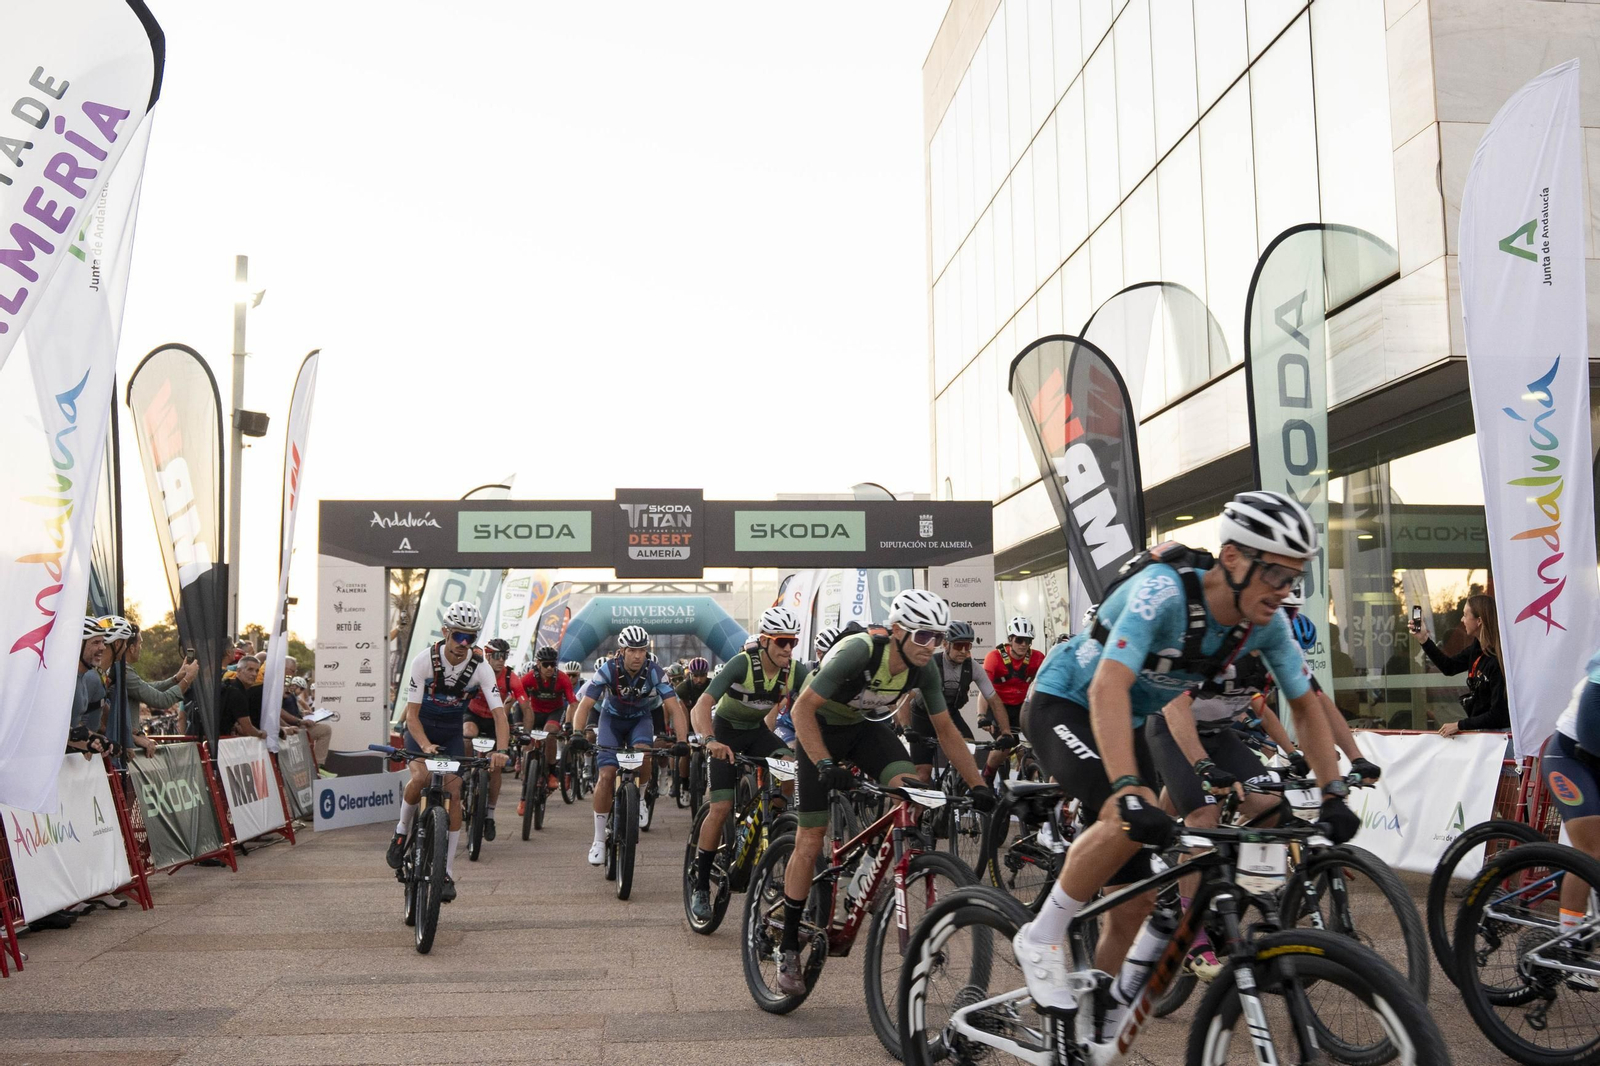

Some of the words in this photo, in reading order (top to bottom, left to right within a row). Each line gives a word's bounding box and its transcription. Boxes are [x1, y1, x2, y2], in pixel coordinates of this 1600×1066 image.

[11, 65, 70, 130] DE
[0, 101, 130, 334] LMERÍA
[1539, 187, 1550, 238] Andalucía
[94, 239, 103, 256] de
[1541, 240, 1550, 254] de
[89, 258, 100, 293] Junta
[1543, 256, 1552, 286] Junta
[1502, 354, 1567, 636] Andalucía
[9, 366, 92, 672] Andalucía
[369, 511, 442, 528] Andalucía
[619, 504, 692, 528] TITAN
[629, 534, 692, 545] DESERT
[880, 540, 926, 548] DIPUTACIÓN
[940, 540, 973, 548] ALMERÍA
[636, 548, 682, 557] ALMERÍA
[852, 568, 867, 616] Cleard
[611, 605, 695, 617] UNIVERSAE
[1353, 615, 1396, 630] RPM
[1053, 724, 1100, 760] GIANT
[776, 759, 790, 768] 101
[338, 790, 393, 810] Cleardent
[1301, 790, 1314, 800] 11
[1356, 793, 1404, 838] lucía
[1259, 846, 1268, 863] 1
